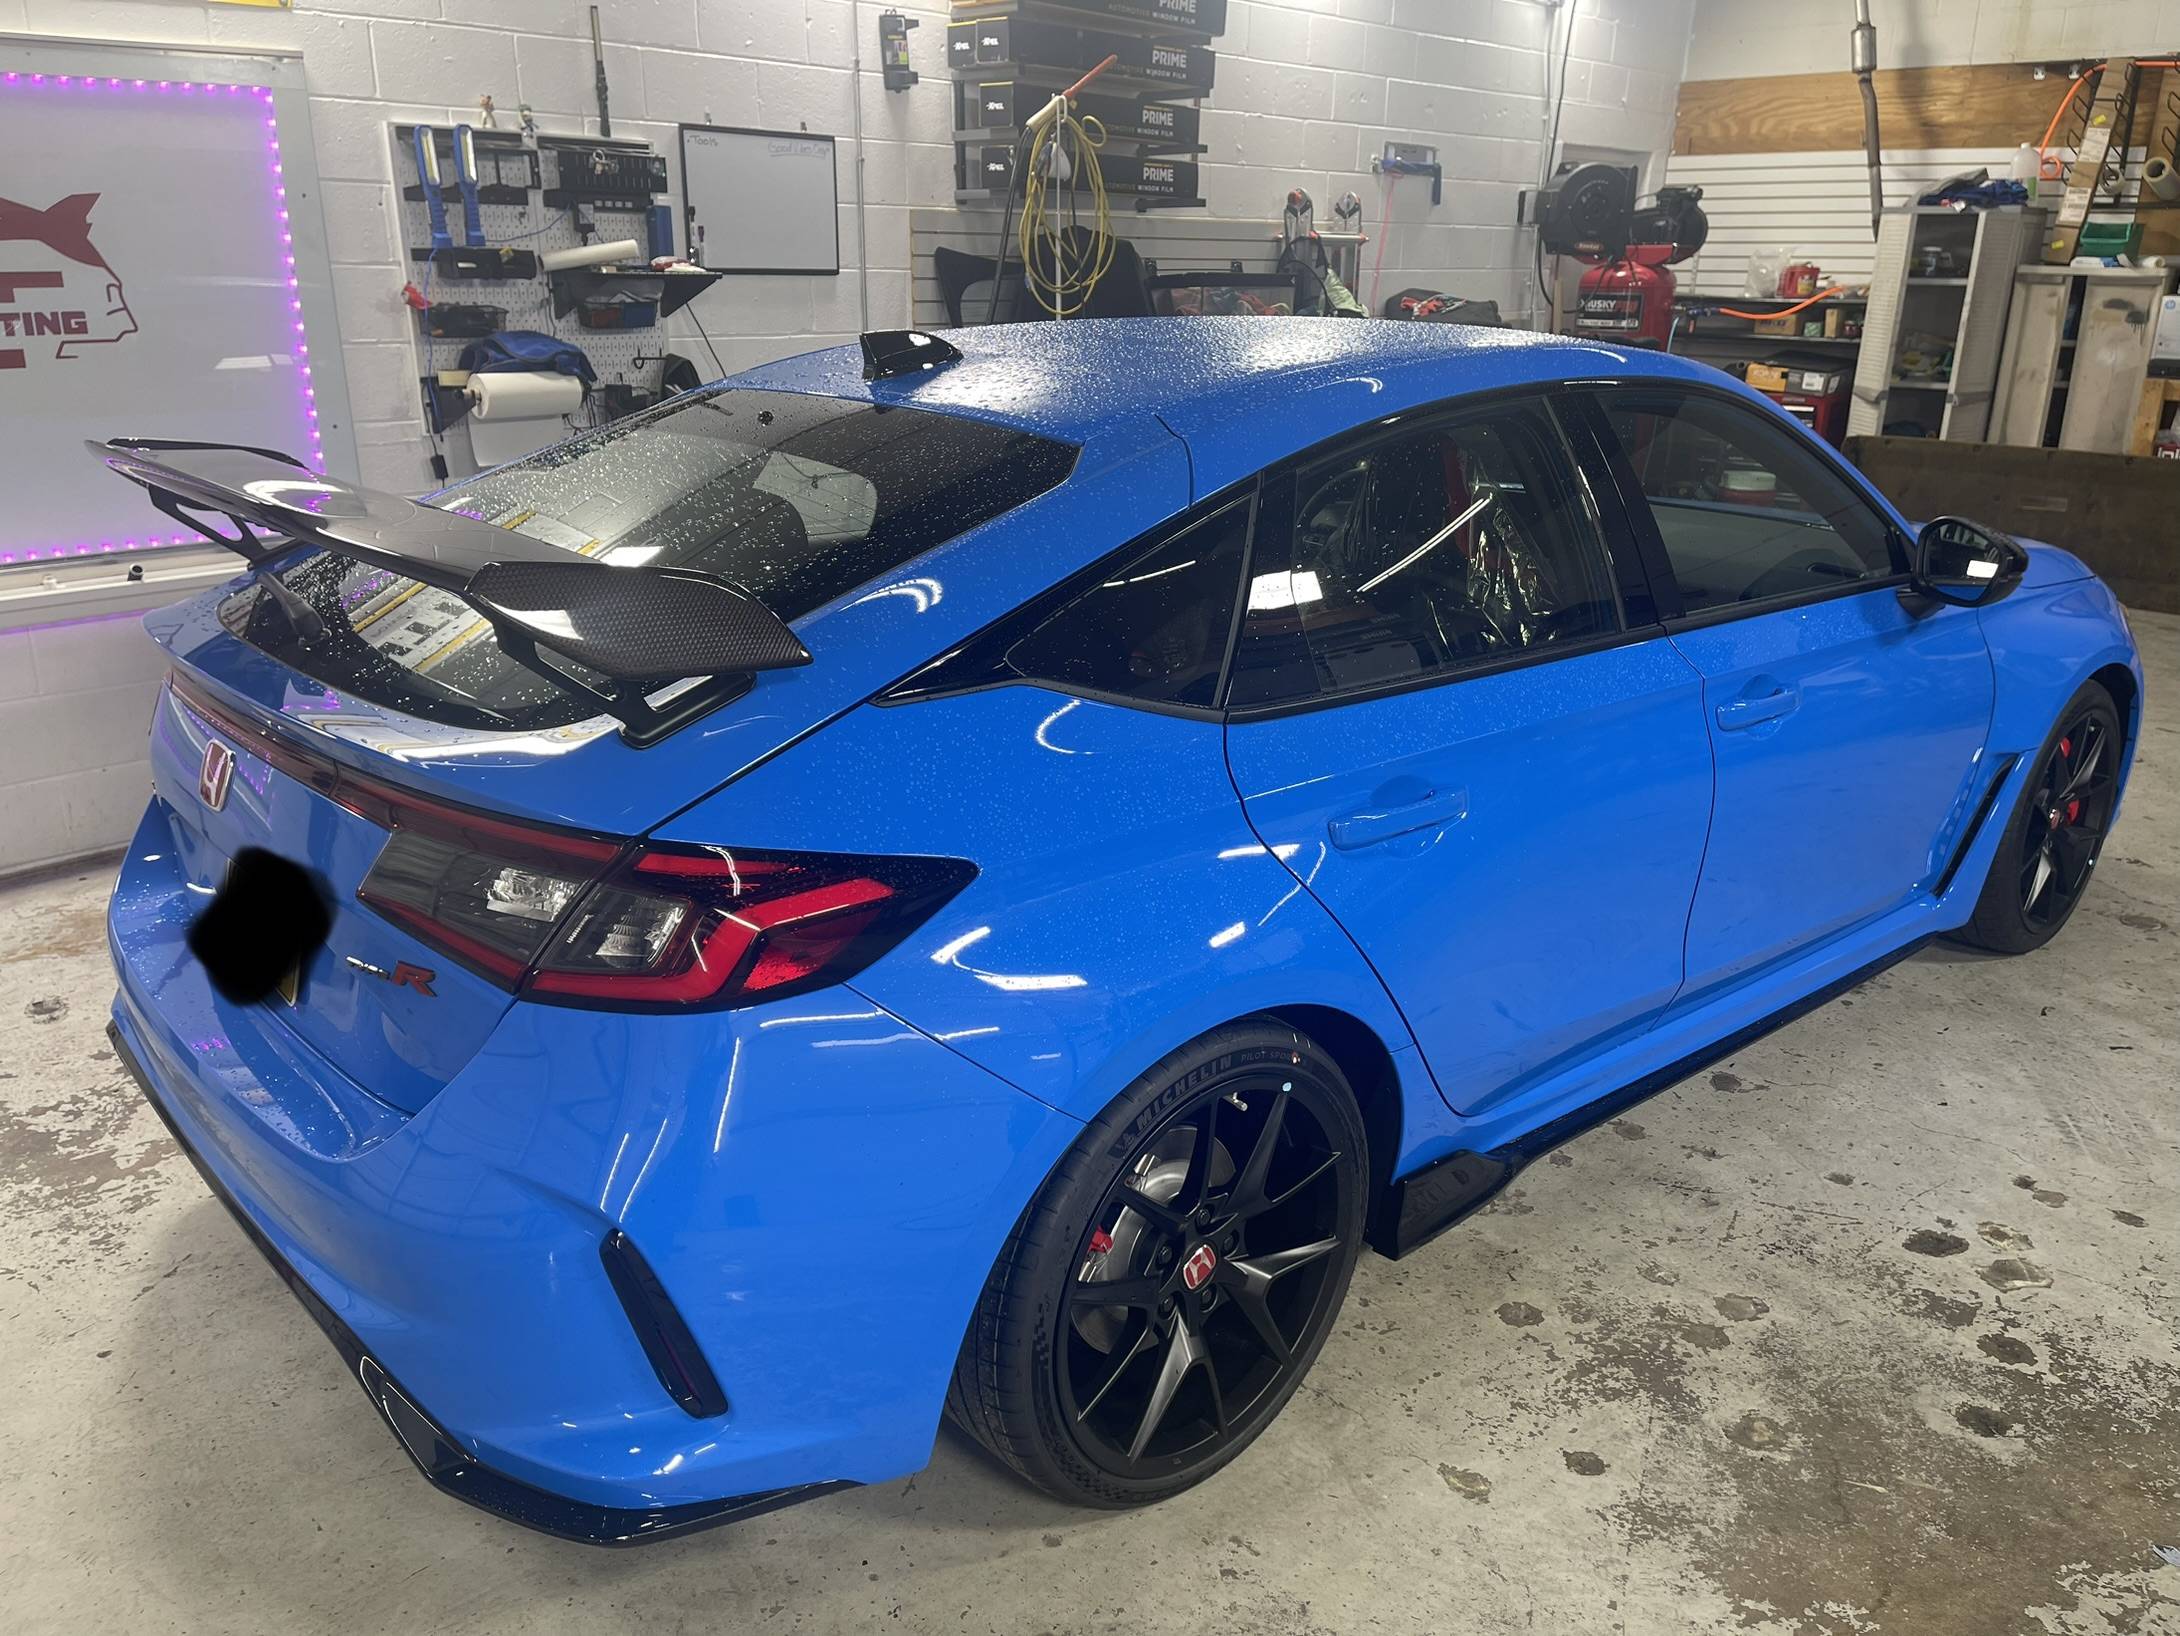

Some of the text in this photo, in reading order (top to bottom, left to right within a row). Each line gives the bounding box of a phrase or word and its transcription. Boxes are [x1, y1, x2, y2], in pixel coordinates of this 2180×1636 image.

[1152, 11, 1179, 21] WINDOW
[1181, 16, 1196, 25] FILM
[1152, 49, 1187, 68] PRIME
[1146, 68, 1171, 77] WINDOW
[1172, 71, 1187, 79] FILM
[1142, 109, 1174, 126] PRIME
[1137, 127, 1159, 136] WINDOW
[1143, 166, 1174, 182] PRIME
[1137, 184, 1159, 192] WINDOW
[1136, 1054, 1233, 1132] MICHELIN
[1240, 1050, 1267, 1063] PILOT
